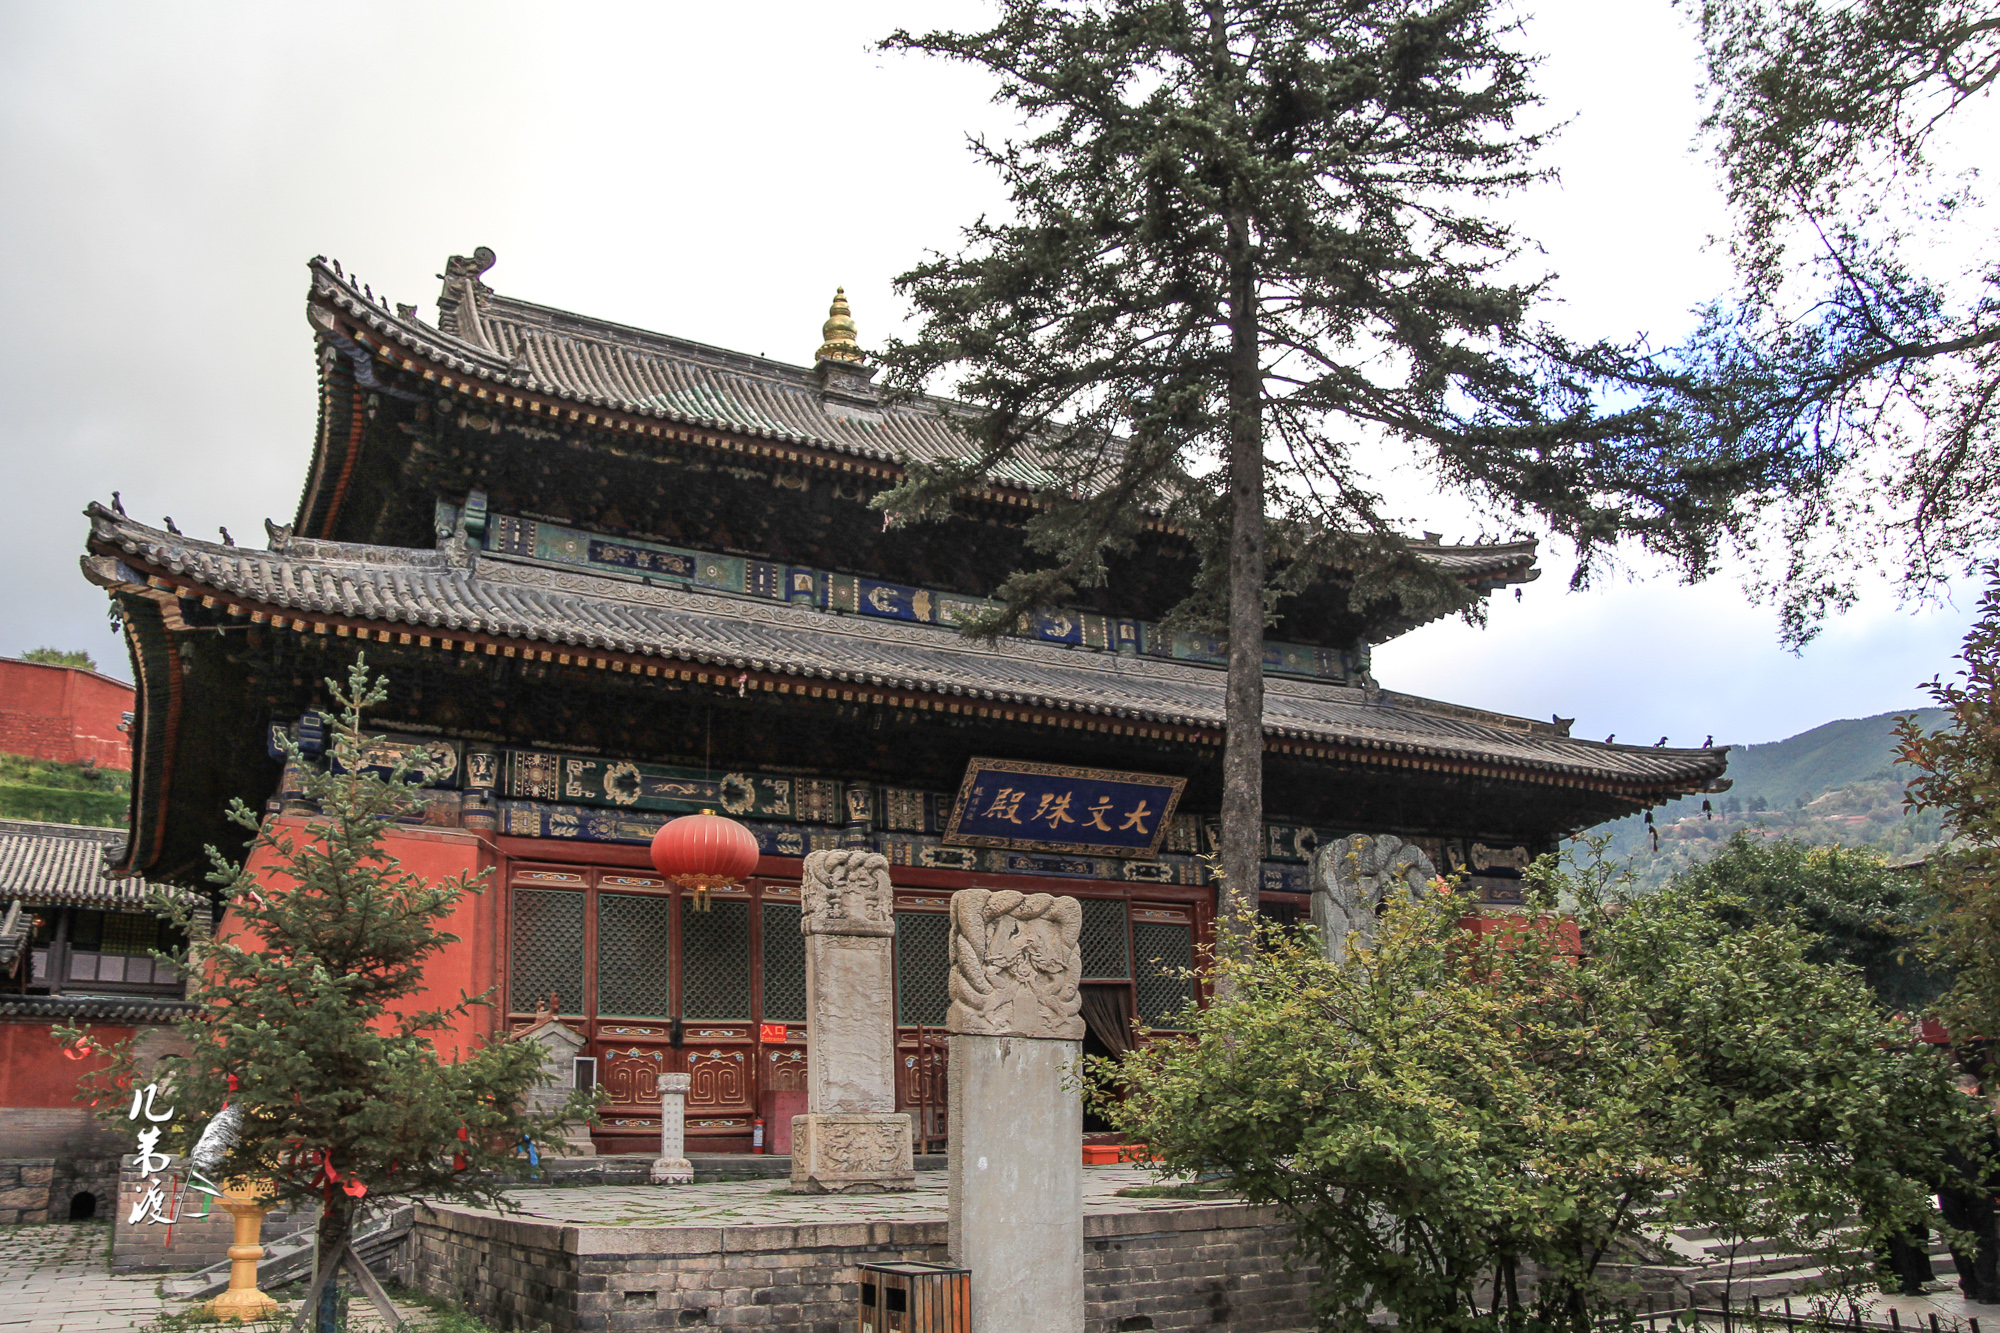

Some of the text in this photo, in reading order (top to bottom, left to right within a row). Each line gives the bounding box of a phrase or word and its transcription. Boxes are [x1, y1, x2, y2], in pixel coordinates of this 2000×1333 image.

[981, 787, 1151, 834] 大文殊殿
[762, 1025, 784, 1036] 入口
